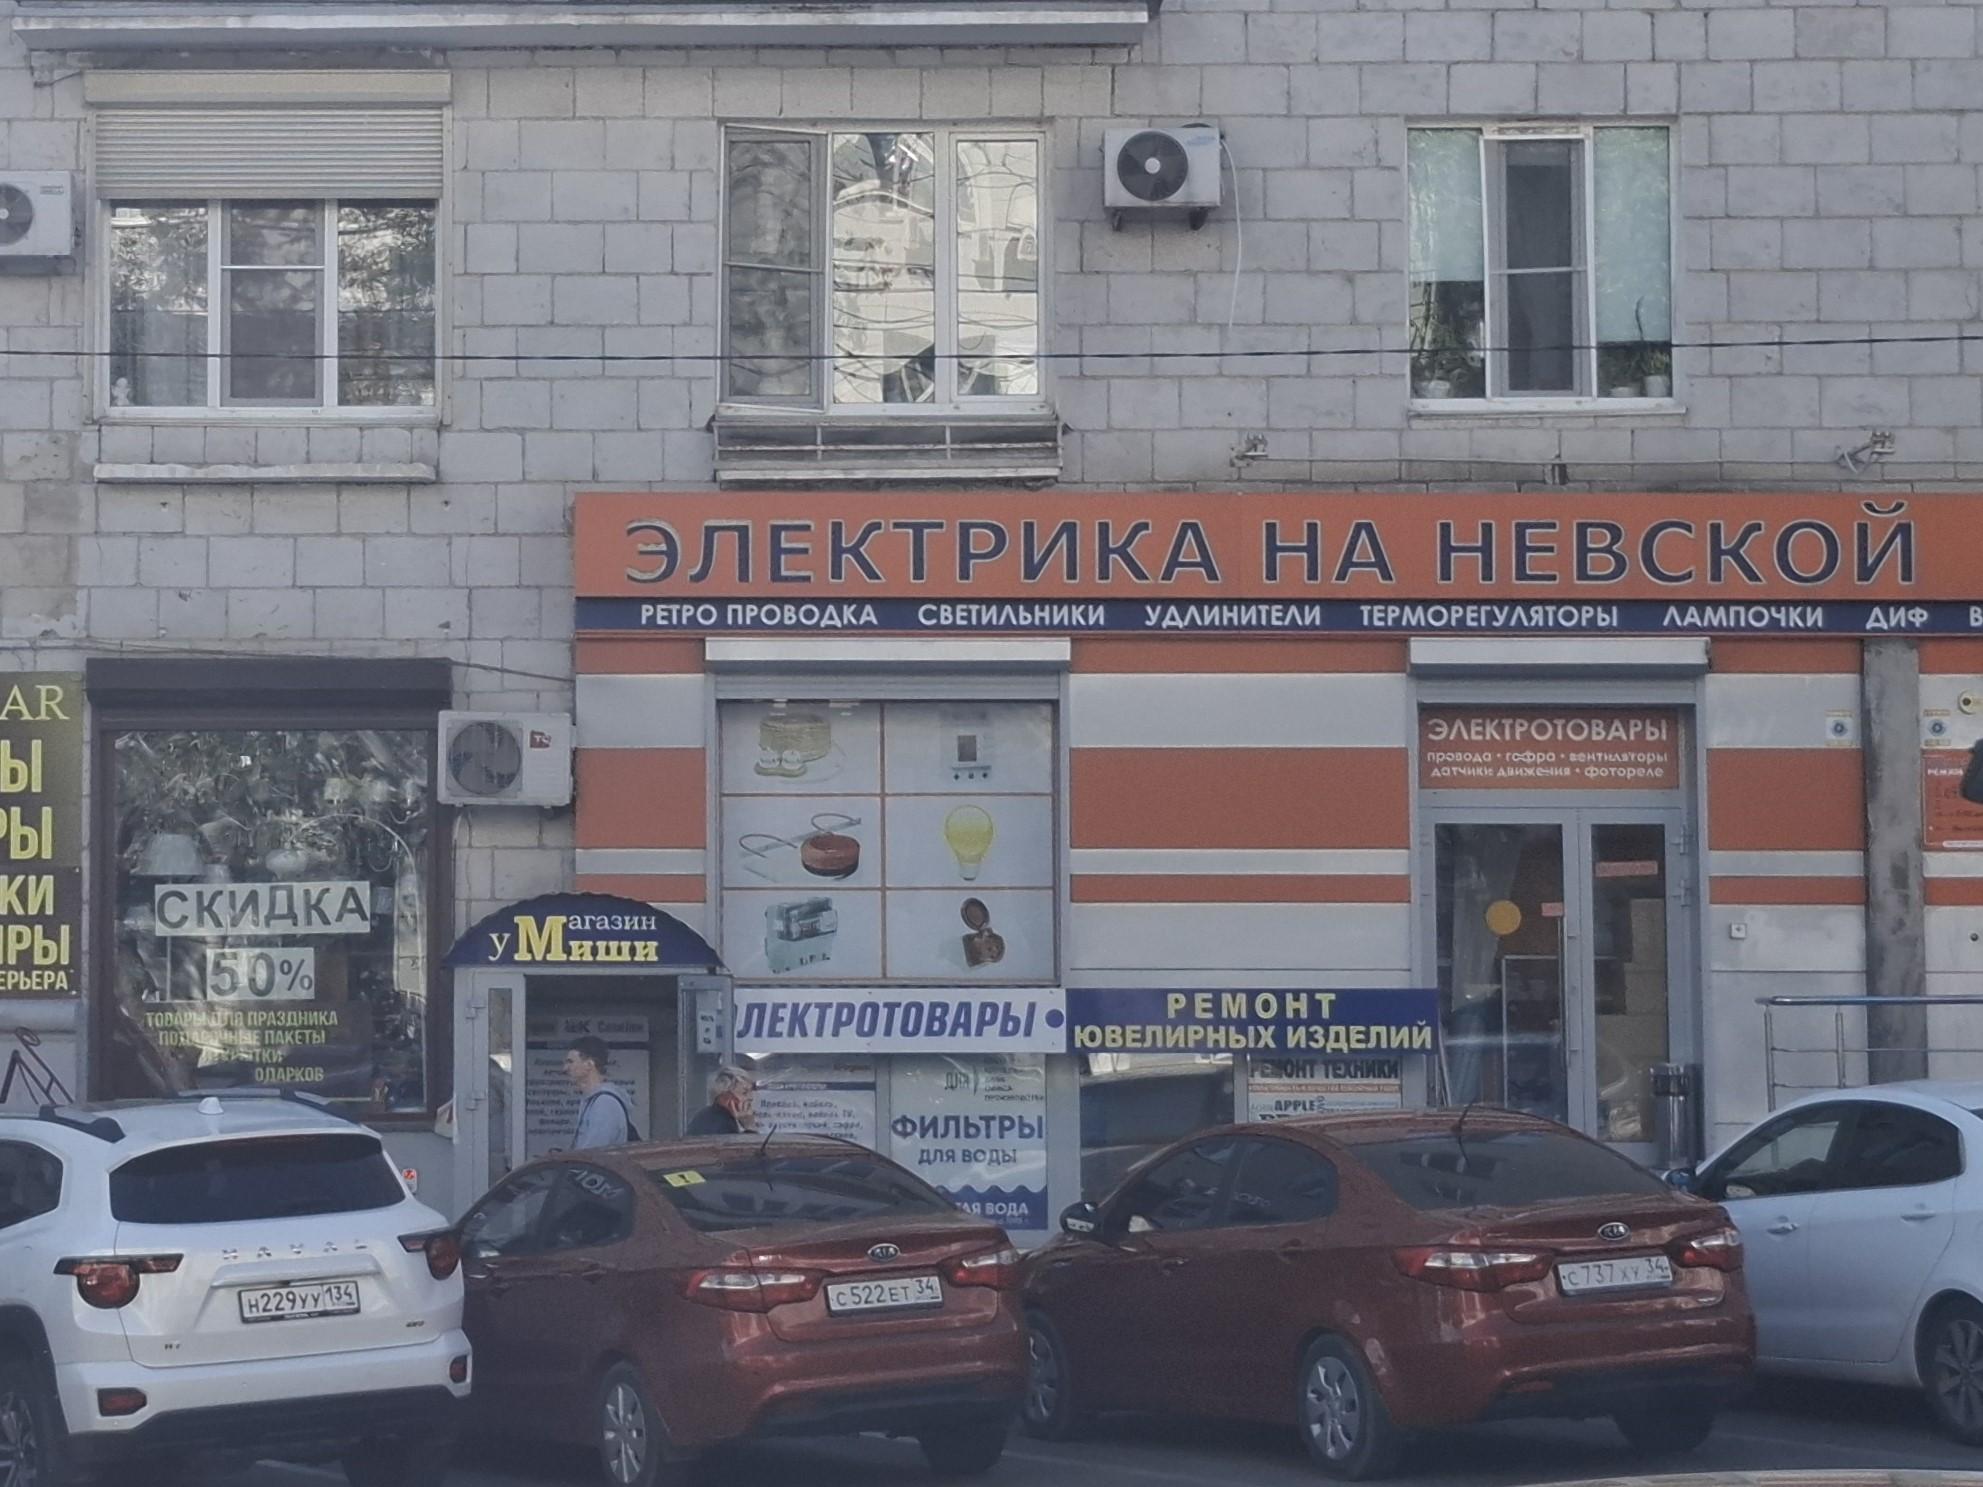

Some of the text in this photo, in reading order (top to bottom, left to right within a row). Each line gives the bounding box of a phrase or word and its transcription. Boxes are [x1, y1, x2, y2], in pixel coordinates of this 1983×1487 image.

[626, 500, 1914, 584] ЭЛЕКТРИКА НА НЕВСКОЙ
[640, 604, 718, 627] РЕТРО
[727, 604, 878, 629] ПРОВОДКА
[917, 604, 1105, 627] СВЕТИЛЬНИКИ
[1145, 604, 1321, 630] УДЛИНИТЕЛИ
[1360, 604, 1618, 627] ТЕРМОРЕГУЛЯТОРЫ
[1663, 604, 1823, 628] ЛАМПОЧКИ
[1866, 605, 1929, 630] ДИФ
[1427, 718, 1667, 741] ЭЛЕКТРОТОВАРЫ
[1427, 752, 1492, 764] провода
[1569, 752, 1668, 763] вентиляторы
[1431, 765, 1664, 779] датчики движения фотореле
[157, 885, 369, 930] СКИДКА
[210, 951, 313, 997] 50%
[1167, 993, 1336, 1019] РЕМОНТ
[248, 1011, 338, 1027] ПРАЗДНИКА
[734, 1001, 1037, 1038] ЛЕКТРОТОВАРЫ
[265, 1030, 325, 1045] ПАКЕТЫ
[1074, 1020, 1432, 1053] ЮВЕЛИРНЫХ ИЗДЕЛИЙ
[1275, 1100, 1315, 1112] APPLE
[891, 1114, 1043, 1139] ФИЛЬТРЫ
[918, 1150, 1017, 1165] ДЛЯ ВОДЫ
[985, 1202, 1029, 1216] ВОДА
